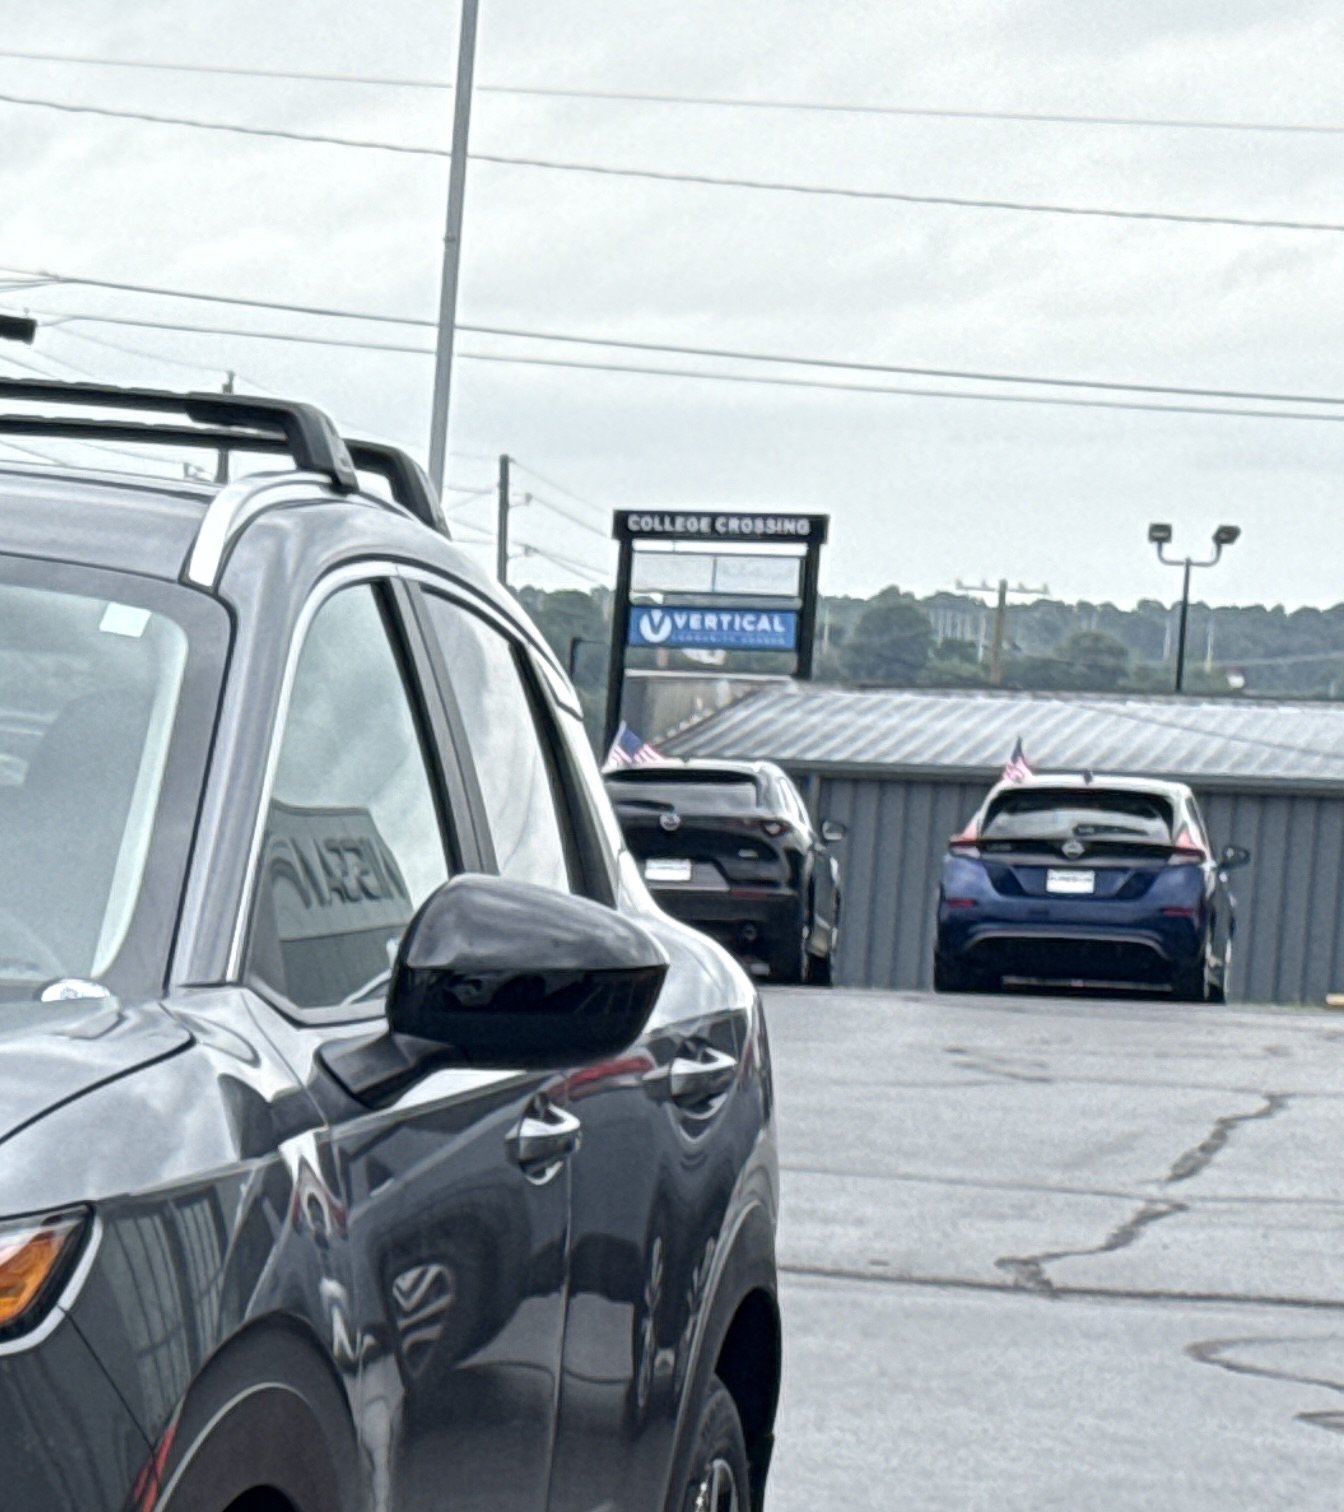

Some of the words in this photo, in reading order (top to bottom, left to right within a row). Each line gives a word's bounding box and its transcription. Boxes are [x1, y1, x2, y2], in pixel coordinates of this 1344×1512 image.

[627, 514, 711, 533] COLLEGE
[715, 516, 811, 536] CROSSING
[673, 611, 785, 633] VERTICAL
